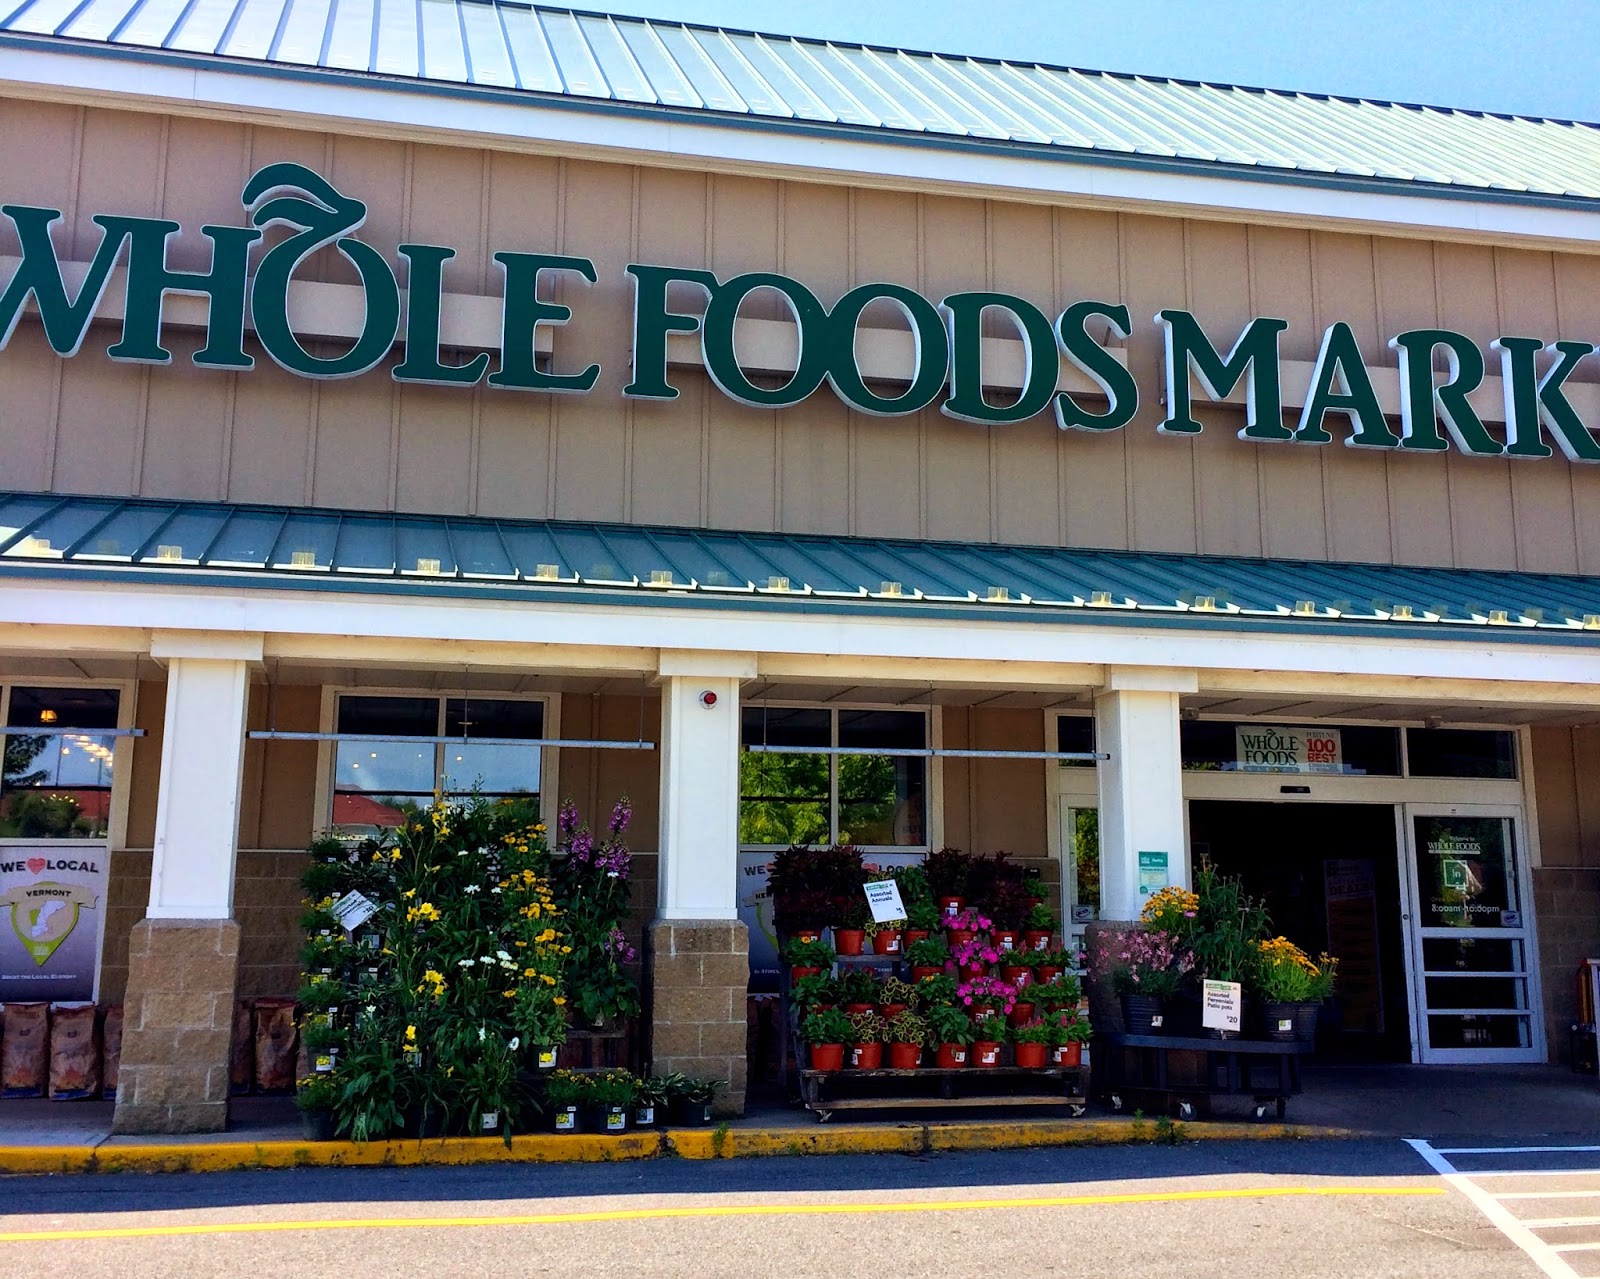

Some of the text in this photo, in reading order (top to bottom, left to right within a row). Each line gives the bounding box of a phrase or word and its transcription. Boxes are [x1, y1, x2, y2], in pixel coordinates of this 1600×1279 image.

[0, 162, 1600, 464] WHOLE FOODS MARK
[1240, 729, 1299, 751] WHOLE
[1306, 738, 1336, 753] 100
[1244, 750, 1297, 765] FOODS
[1307, 753, 1336, 763] BEST
[1427, 840, 1481, 851] WHOLE FOODS
[0, 860, 99, 873] WE LOCAL
[744, 864, 765, 876] WE
[26, 889, 72, 897] VERMONT
[755, 892, 773, 900] NEW
[1431, 903, 1460, 912] 8:00am
[1207, 991, 1230, 999] Assorted
[1226, 1015, 1238, 1023] $20
